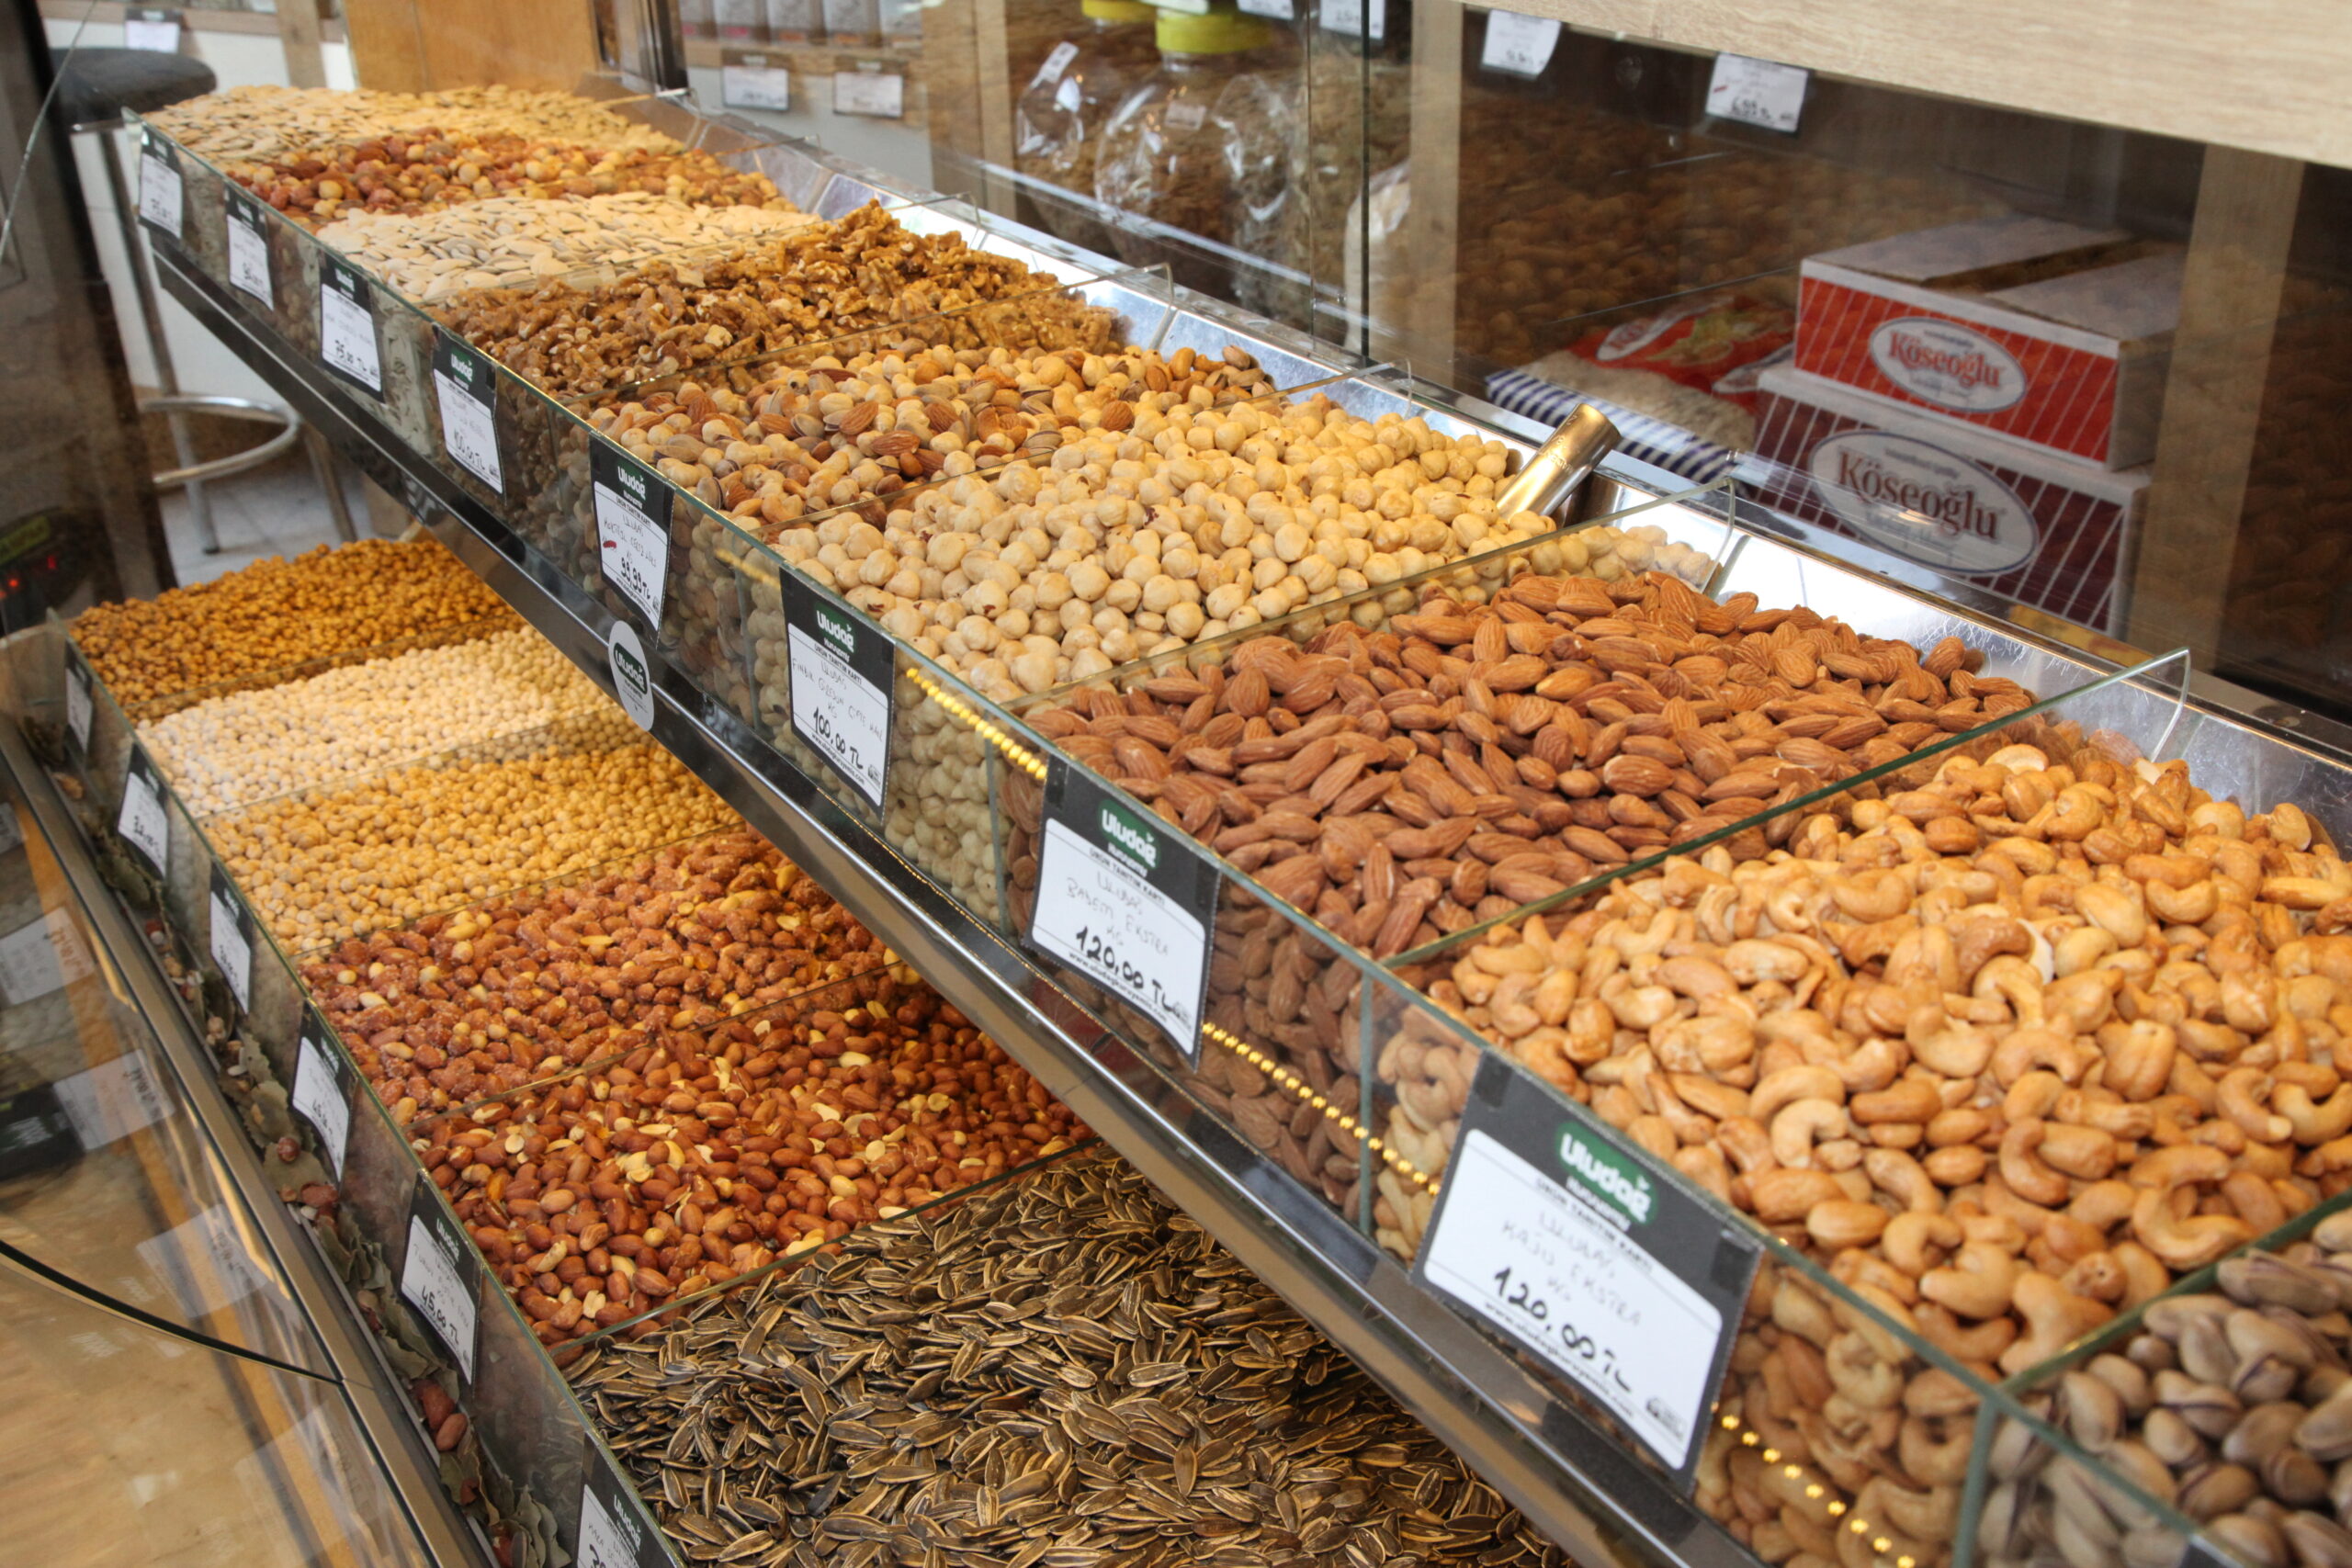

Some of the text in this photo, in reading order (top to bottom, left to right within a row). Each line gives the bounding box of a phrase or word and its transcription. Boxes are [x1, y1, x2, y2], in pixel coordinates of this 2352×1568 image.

[617, 466, 646, 501] Uludağ
[1839, 451, 1997, 540] Köseoğlu
[816, 610, 854, 653] Uludağ
[849, 745, 864, 770] TL
[1102, 809, 1157, 868] Uludağ
[1151, 978, 1177, 1013] TL
[1560, 1131, 1653, 1224] Uludağ
